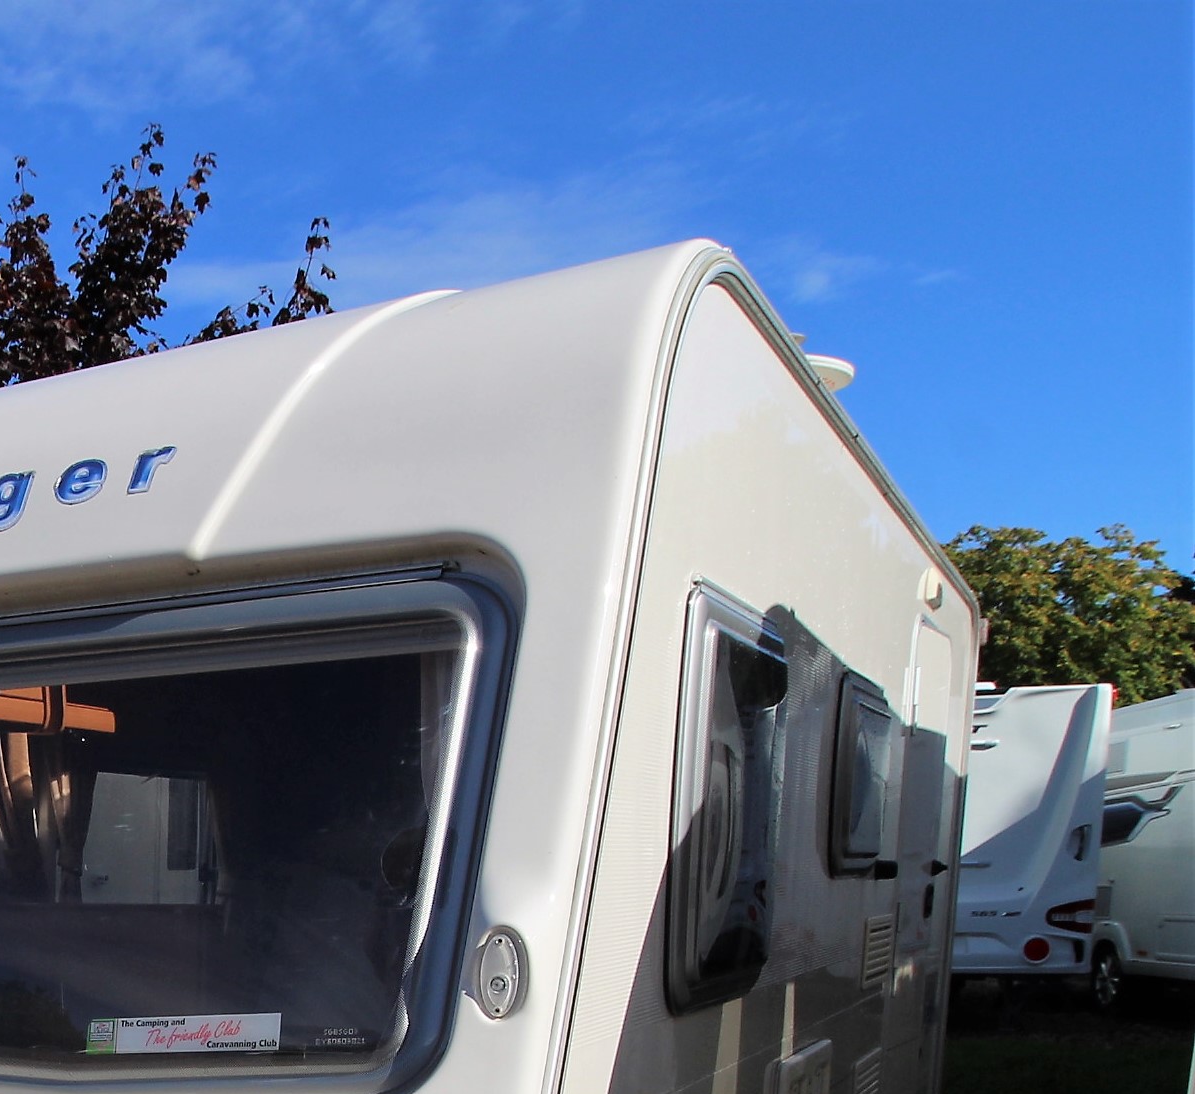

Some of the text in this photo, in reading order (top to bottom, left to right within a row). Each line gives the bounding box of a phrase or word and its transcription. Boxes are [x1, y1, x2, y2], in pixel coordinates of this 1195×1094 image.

[136, 1019, 169, 1028] Camping
[170, 1018, 186, 1026] and
[146, 1020, 242, 1049] The friendly Club
[206, 1039, 278, 1049] Caravanning Club
